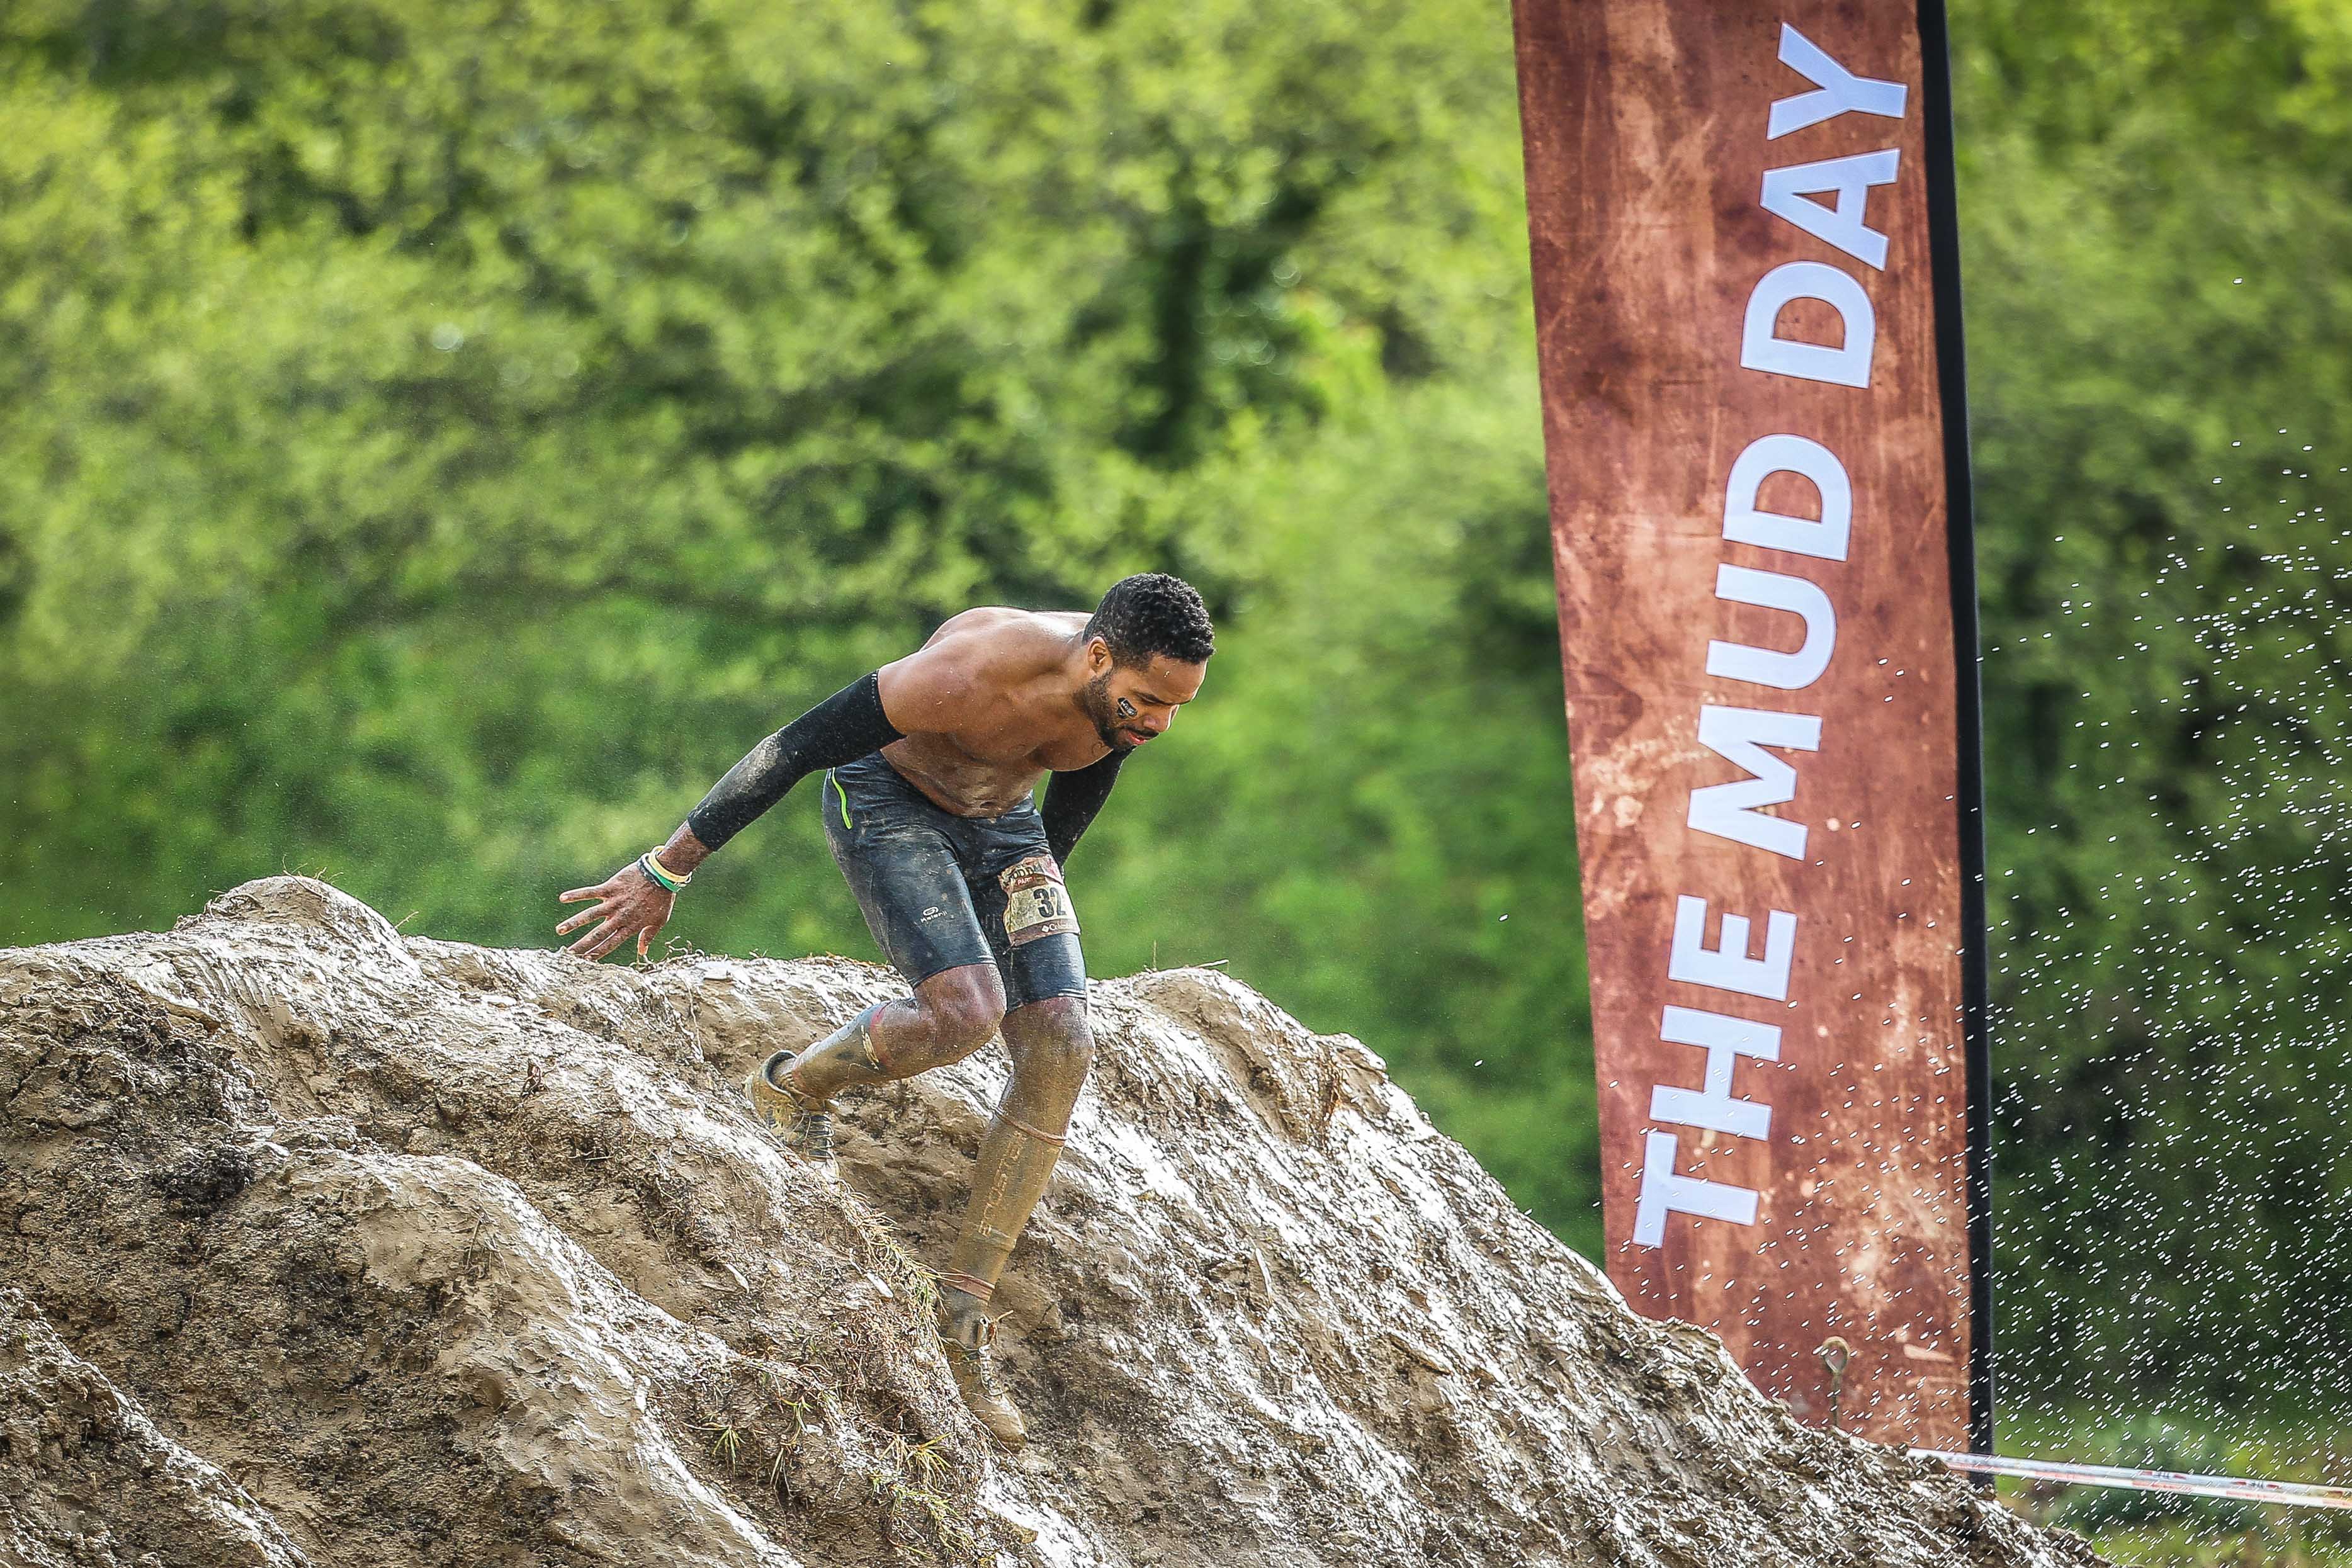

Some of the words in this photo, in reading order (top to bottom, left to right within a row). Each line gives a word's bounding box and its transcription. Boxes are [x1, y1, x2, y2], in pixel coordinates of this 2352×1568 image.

[1740, 21, 1908, 389] DAY
[1687, 433, 1852, 860] MUD
[1034, 888, 1066, 918] 32
[1632, 895, 1797, 1249] THE
